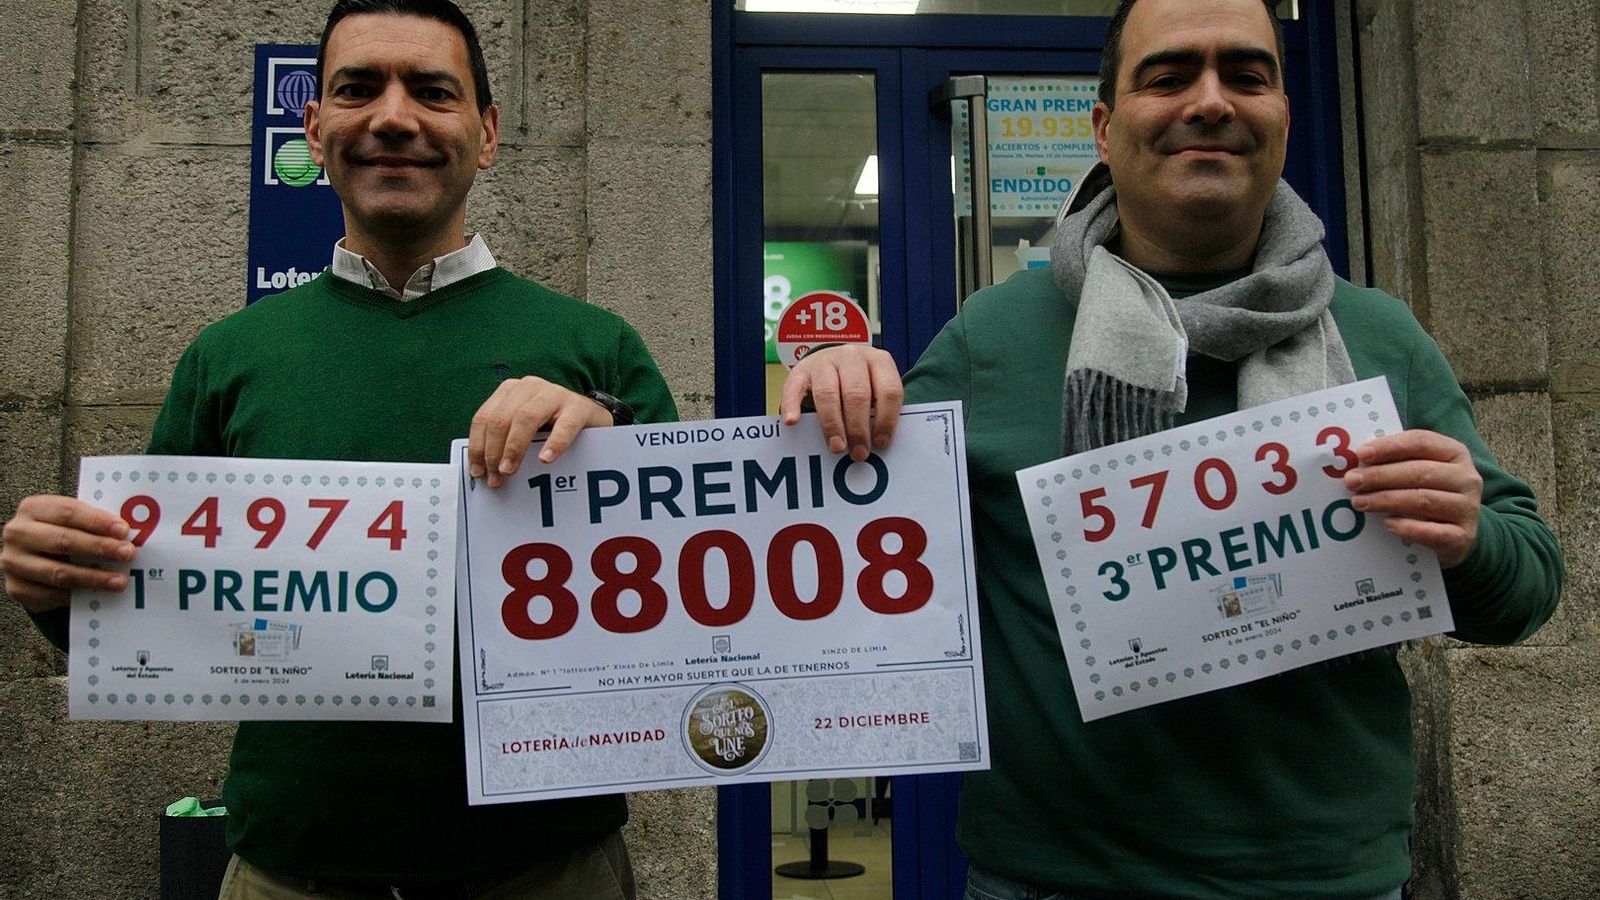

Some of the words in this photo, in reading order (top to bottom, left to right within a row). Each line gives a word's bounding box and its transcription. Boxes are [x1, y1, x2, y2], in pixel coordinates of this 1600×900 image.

[988, 99, 1037, 112] GRAN
[1043, 99, 1096, 112] PREM
[995, 143, 1041, 151] ACIERTOS
[991, 178, 1072, 193] ENDIDO
[795, 301, 848, 331] +18
[635, 428, 725, 447] VENDIDO
[732, 420, 781, 441] AQUÍ
[586, 452, 890, 524] PREMIO
[1079, 426, 1359, 543] 57033
[120, 494, 408, 551] 94974
[1147, 498, 1367, 591] PREMIO
[178, 568, 398, 613] PREMIO
[501, 516, 935, 641] 88008
[1202, 627, 1238, 643] SORTEO
[1241, 624, 1253, 633] DE
[685, 655, 718, 665] Lotería
[721, 652, 761, 662] Nacional
[864, 645, 888, 653] LIMIA
[210, 667, 247, 675] SORTEO
[598, 678, 615, 687] NO
[618, 675, 641, 685] HAY
[644, 672, 683, 683] MAYOR
[686, 669, 728, 681] SUERTE
[731, 668, 754, 677] QUE
[757, 667, 771, 675] LA
[774, 665, 789, 674] DE
[791, 661, 850, 673] TENERNOS
[814, 717, 833, 729] 22
[839, 712, 930, 728] DICIEMBRE
